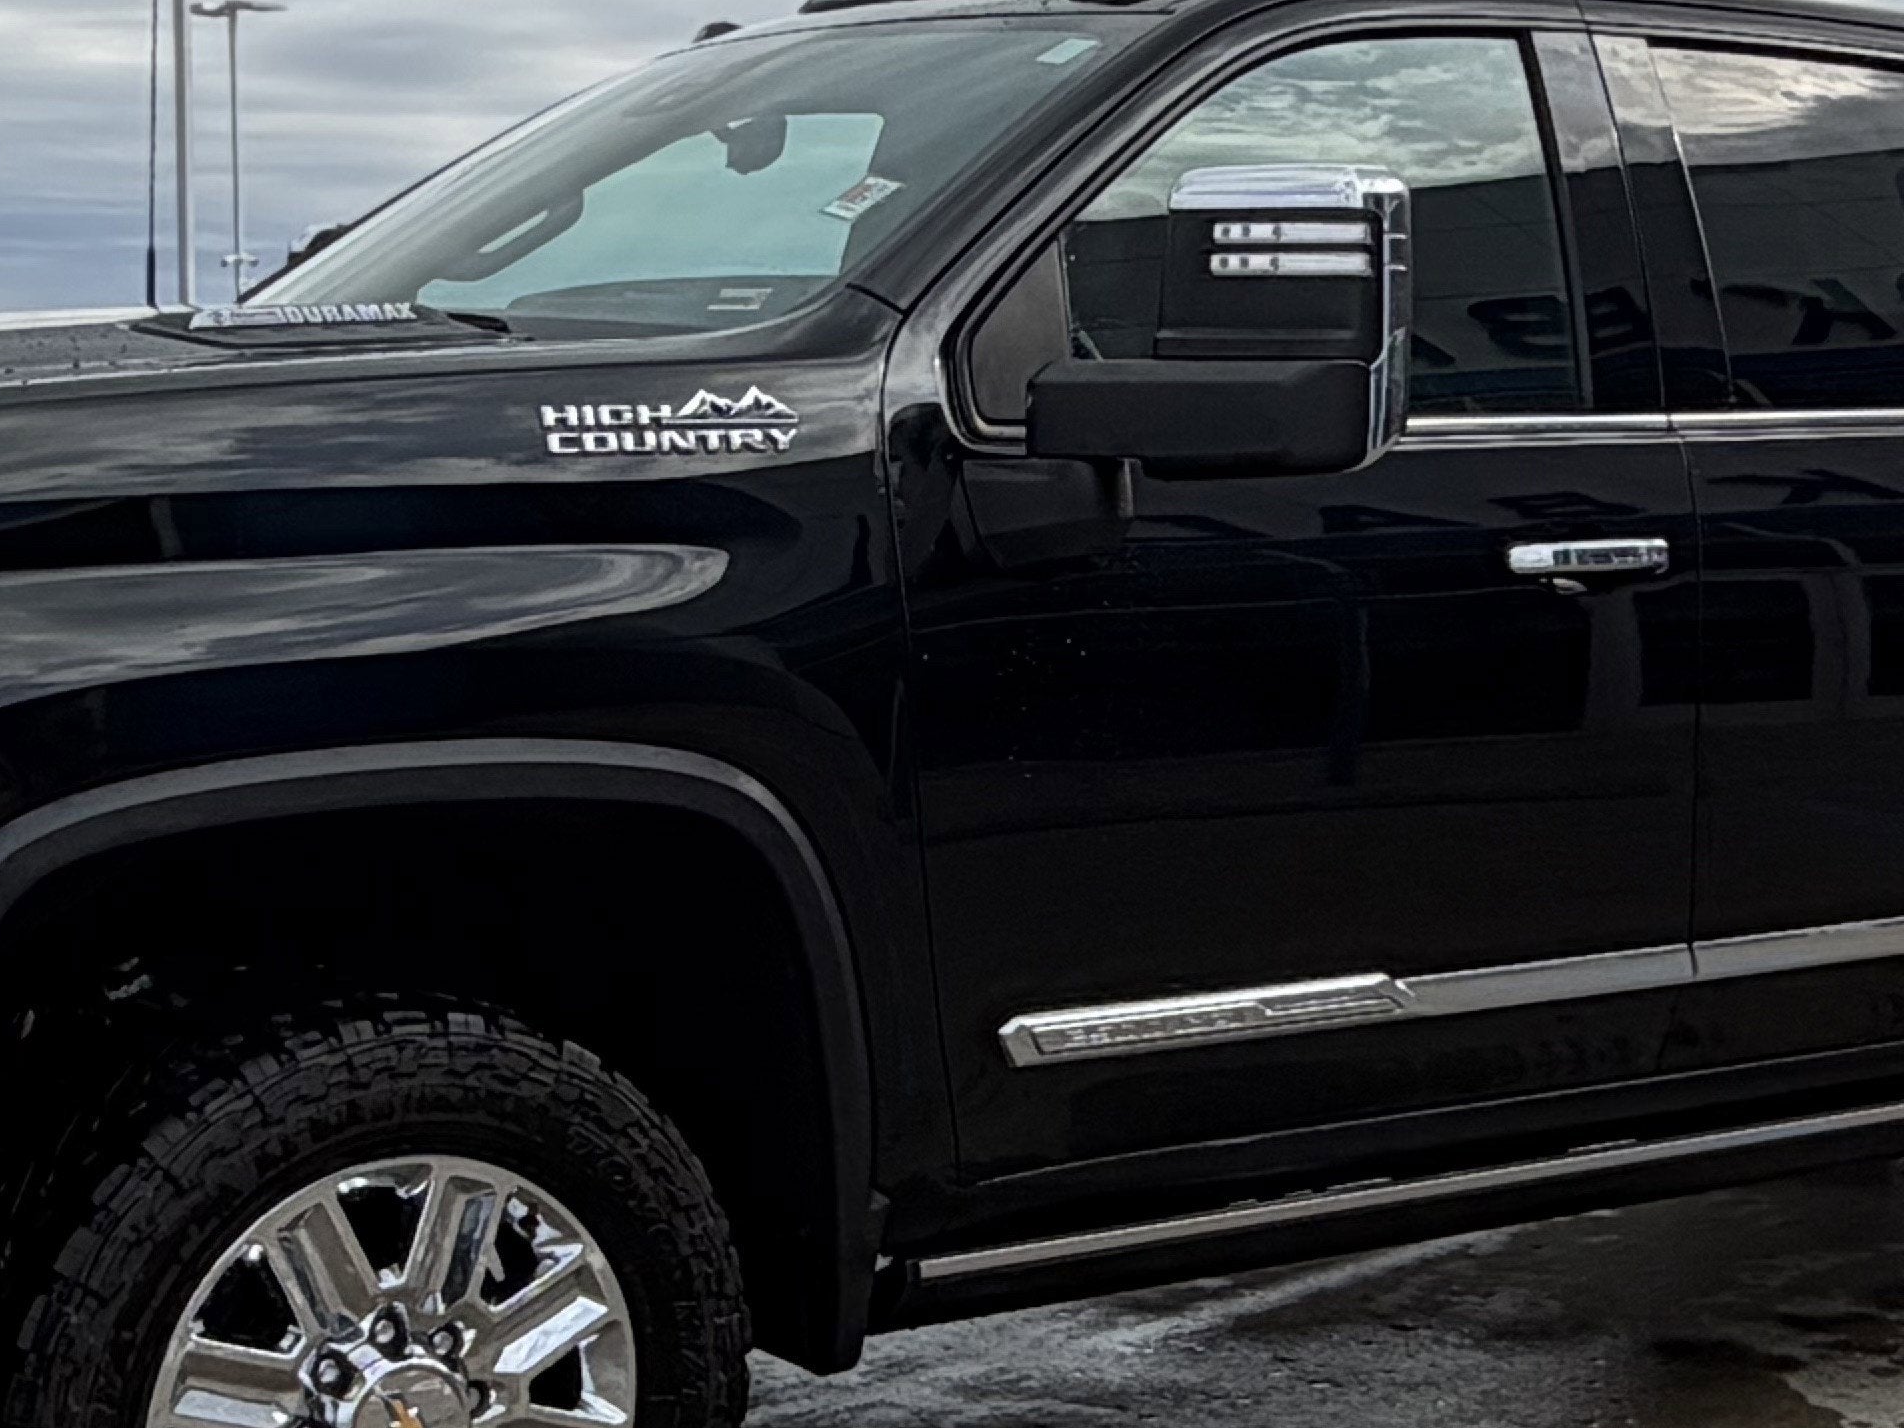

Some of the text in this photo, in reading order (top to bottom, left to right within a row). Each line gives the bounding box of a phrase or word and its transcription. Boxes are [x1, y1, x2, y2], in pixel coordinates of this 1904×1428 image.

[282, 302, 417, 324] DURAMAX
[540, 404, 672, 427] HIGH
[546, 428, 798, 454] COUNTRY
